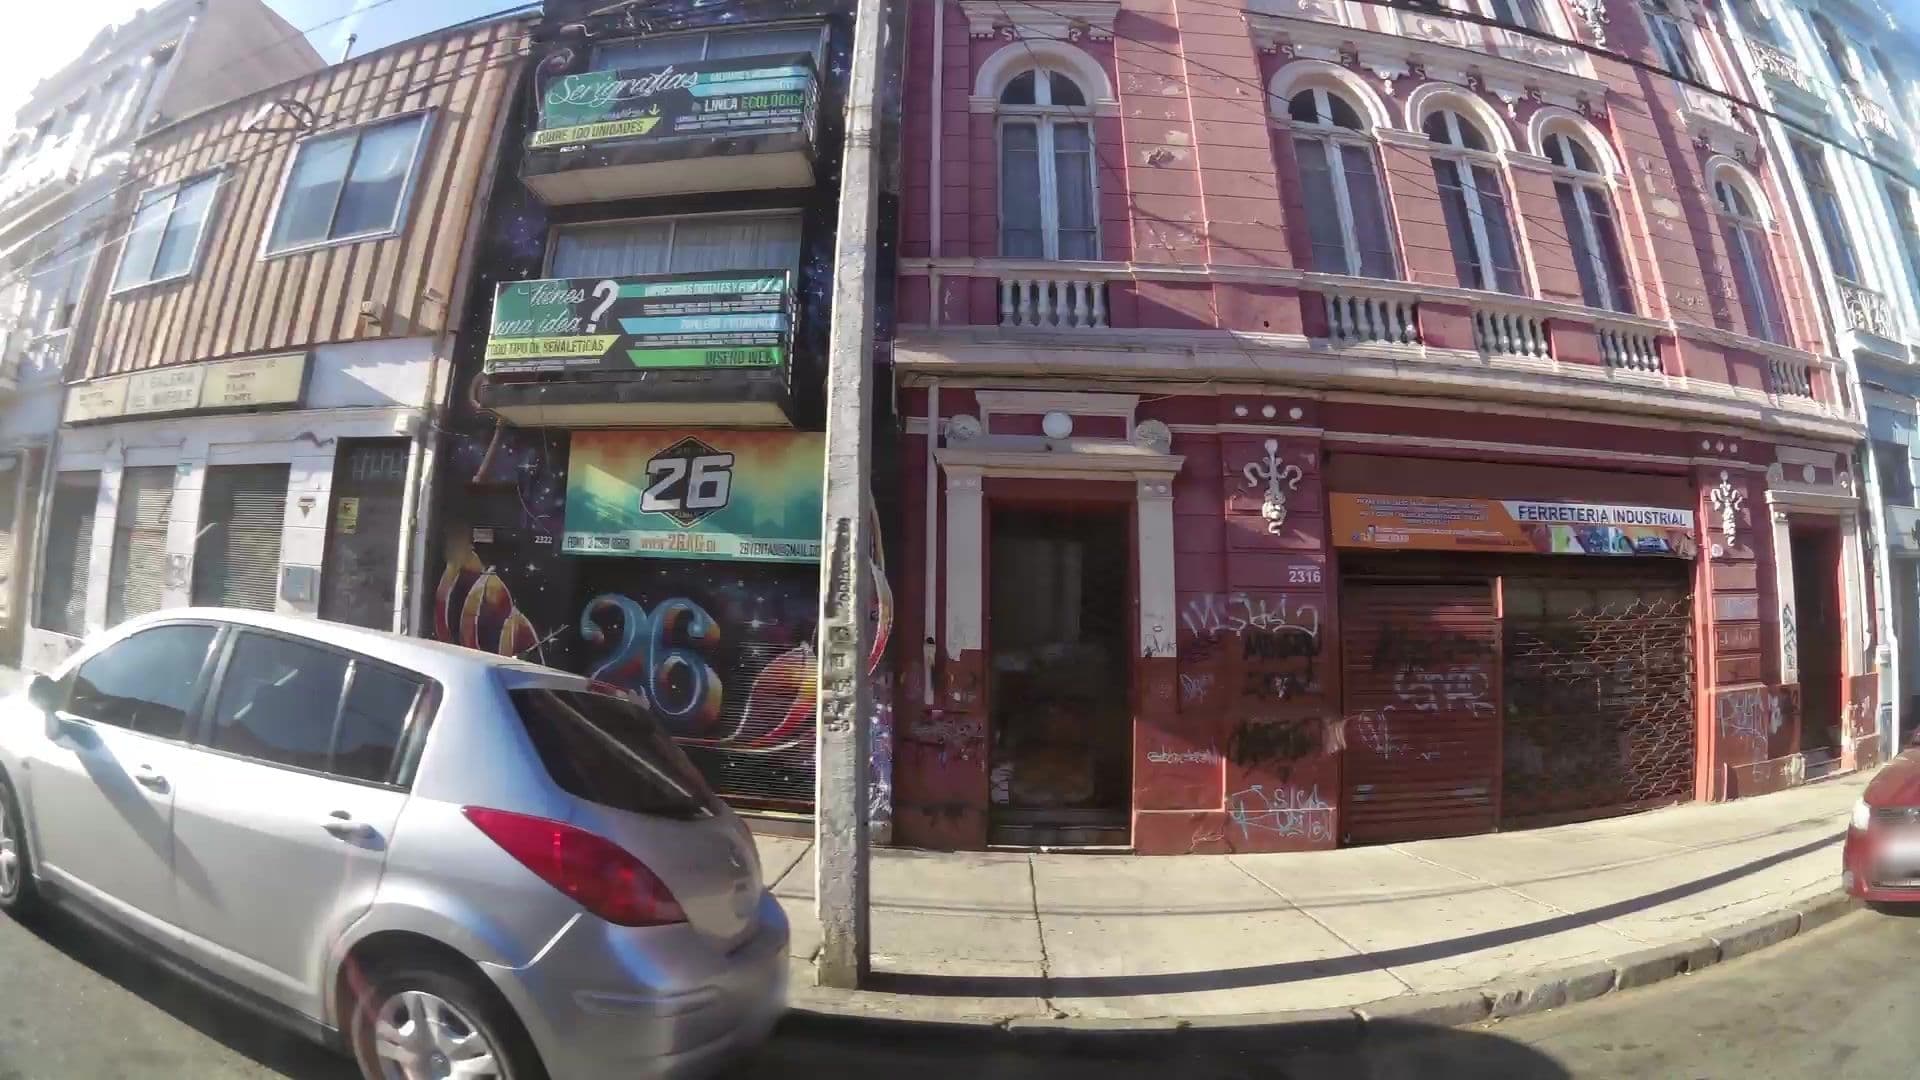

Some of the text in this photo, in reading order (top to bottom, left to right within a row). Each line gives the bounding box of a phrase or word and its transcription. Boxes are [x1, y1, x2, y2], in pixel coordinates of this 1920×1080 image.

[592, 120, 644, 137] UNIDADES
[640, 452, 735, 513] 26
[1518, 505, 1686, 527] FERRETERIA INDUSTRIAL
[1288, 570, 1321, 583] 2316
